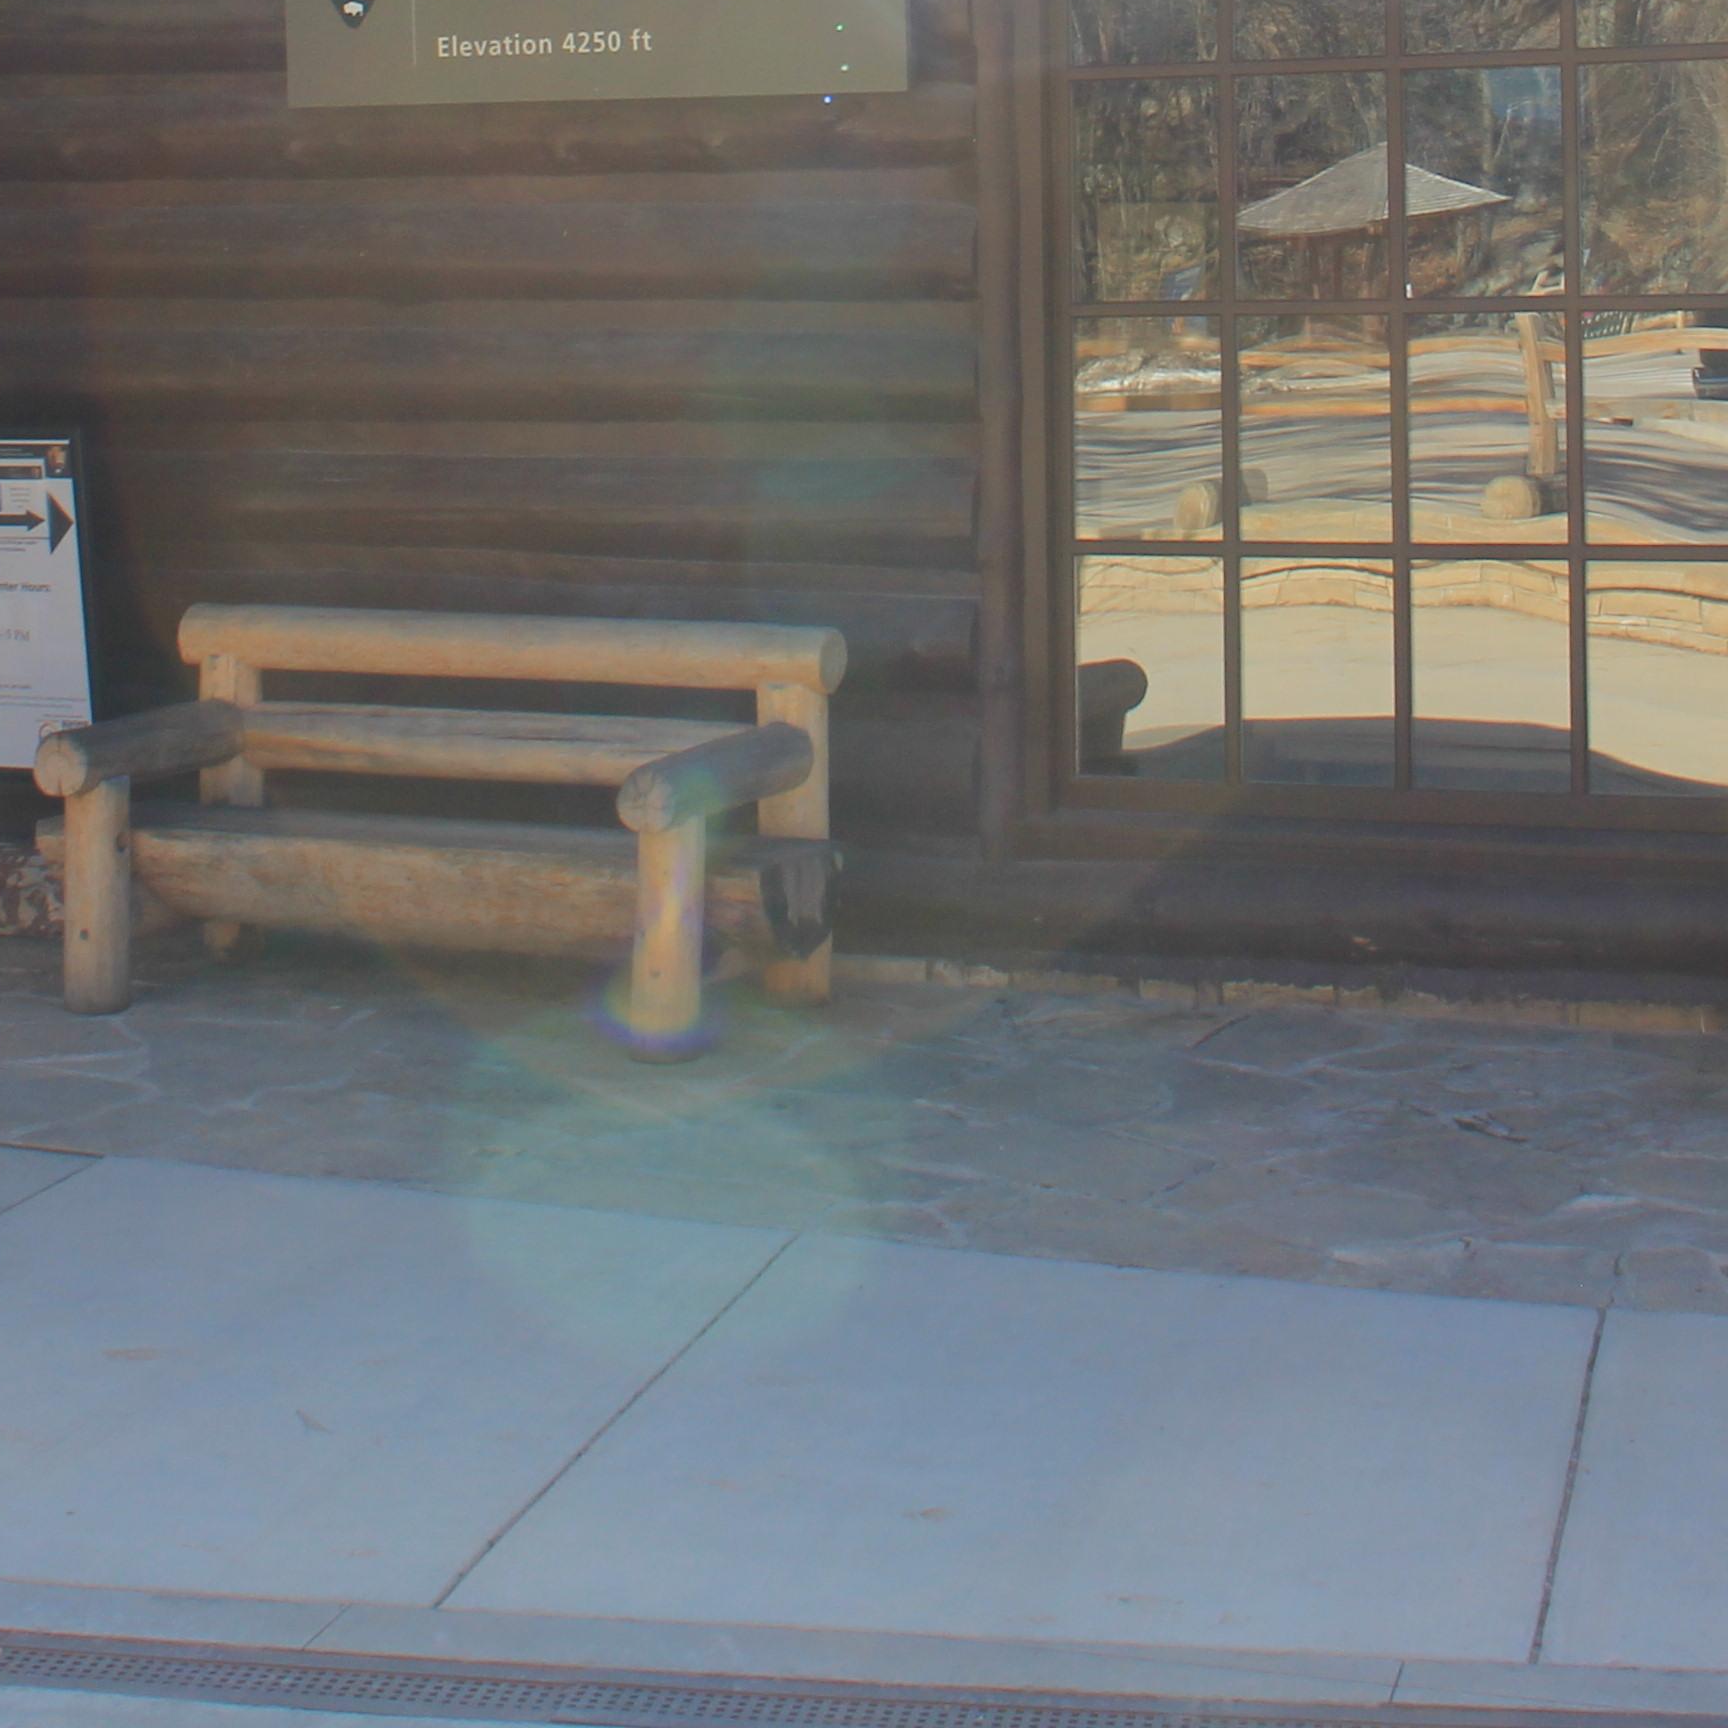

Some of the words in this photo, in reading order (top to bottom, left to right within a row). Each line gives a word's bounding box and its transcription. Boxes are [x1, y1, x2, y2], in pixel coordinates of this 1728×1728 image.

[437, 33, 553, 57] Elevation
[562, 30, 622, 54] 4250
[630, 28, 653, 51] ft
